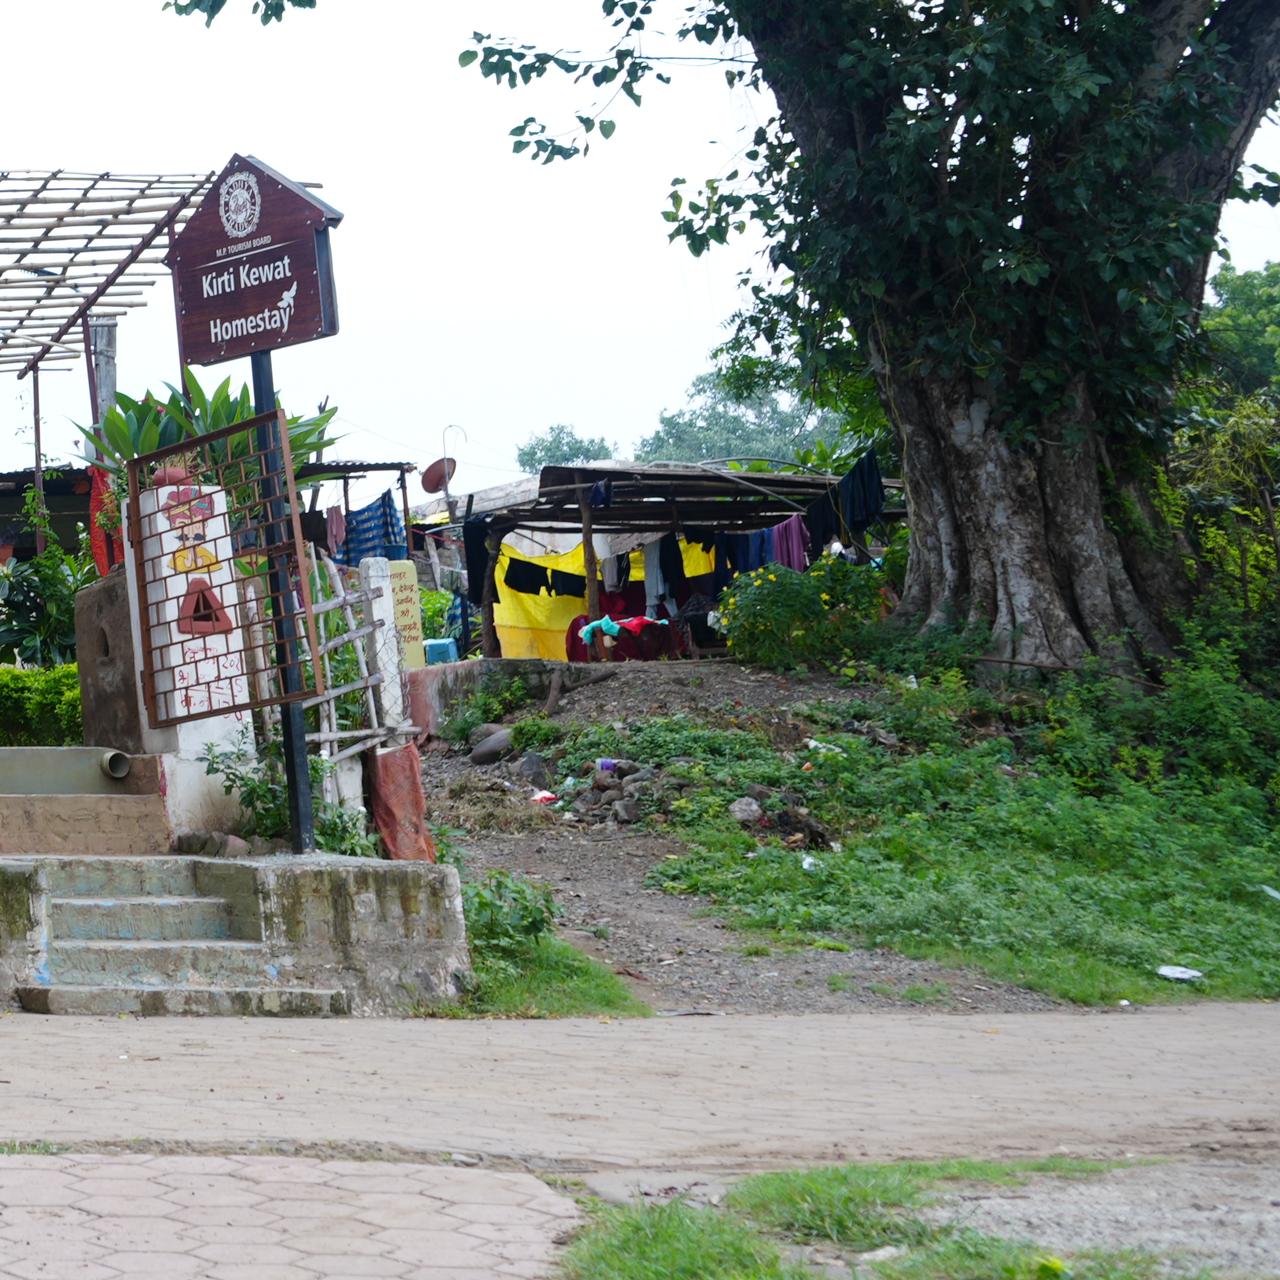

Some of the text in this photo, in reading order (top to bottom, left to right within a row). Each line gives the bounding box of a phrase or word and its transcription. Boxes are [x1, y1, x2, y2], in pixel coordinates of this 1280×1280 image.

[216, 235, 272, 257] M.P. TOURISM BOARD
[202, 255, 292, 298] Kirti Kewat
[210, 307, 290, 344] Homestay
